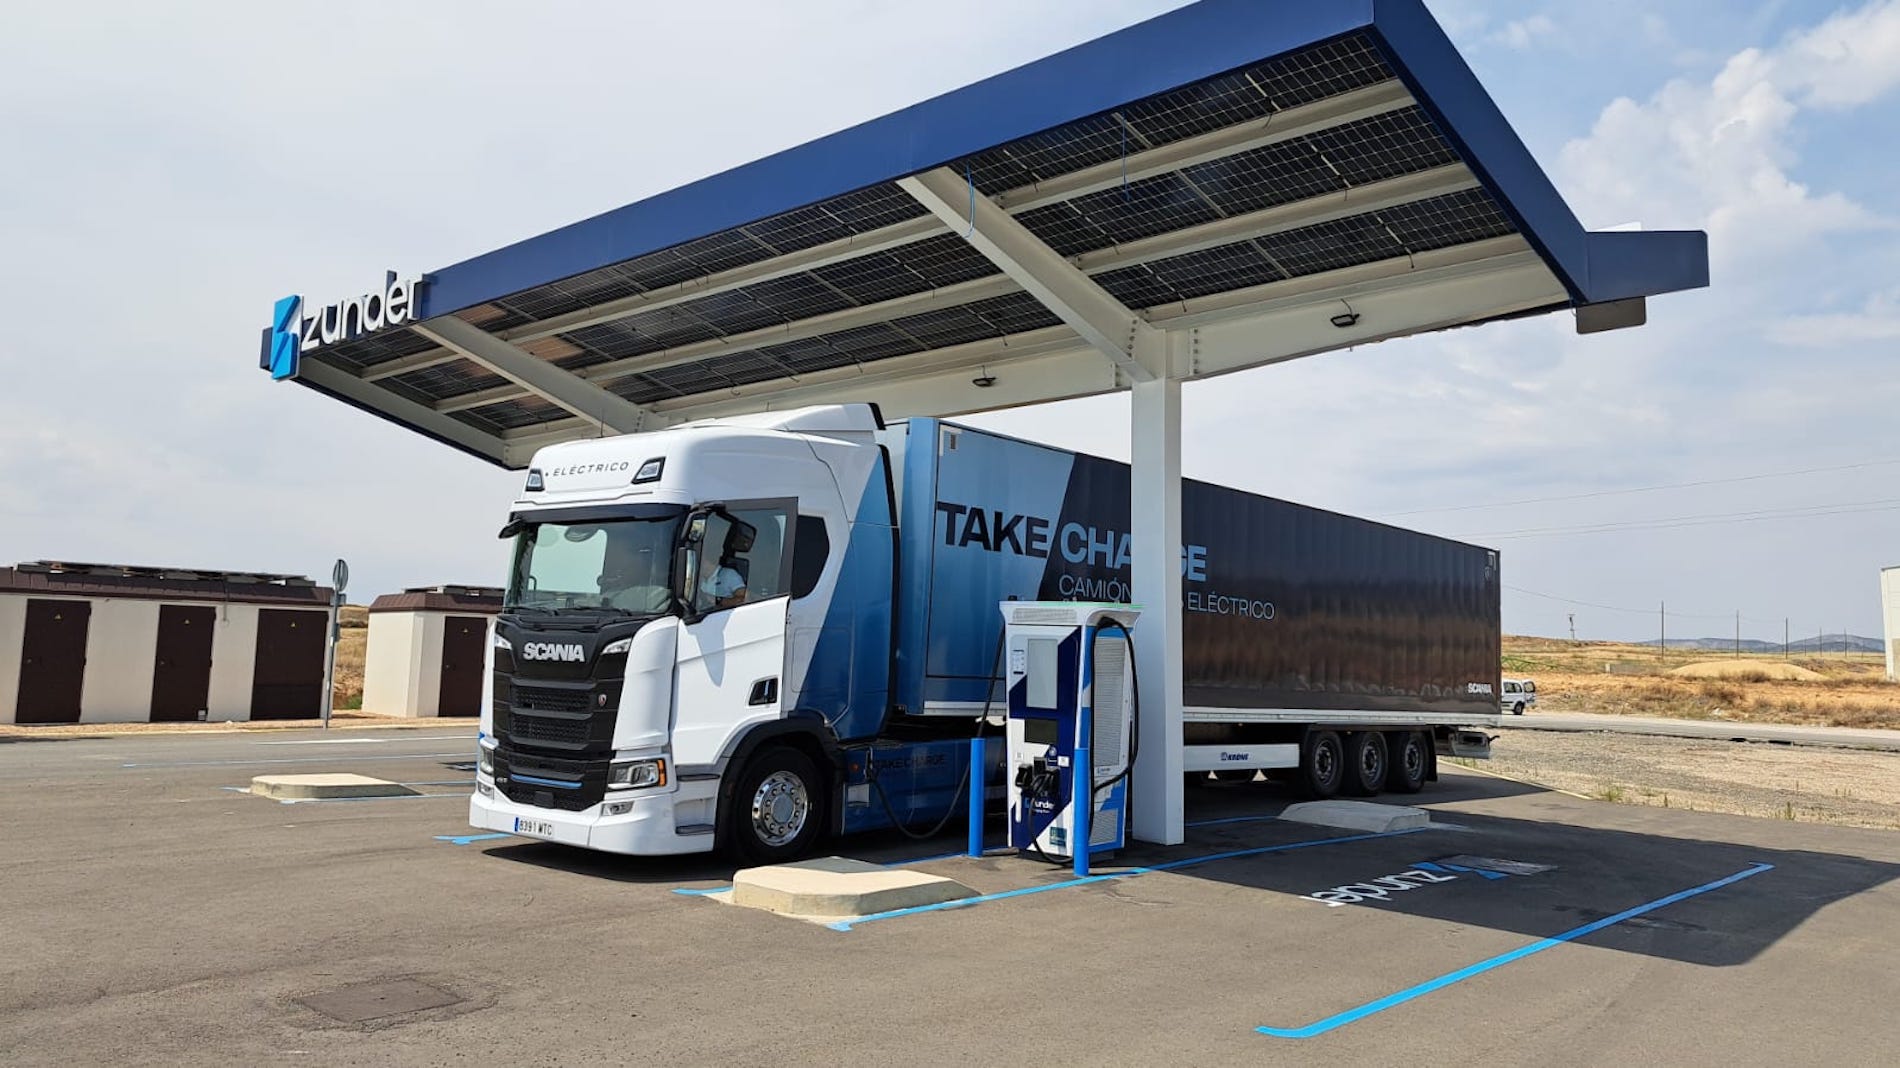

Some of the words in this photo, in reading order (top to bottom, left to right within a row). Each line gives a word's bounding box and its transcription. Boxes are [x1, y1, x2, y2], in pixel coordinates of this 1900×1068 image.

[301, 270, 418, 351] zunder
[936, 500, 1050, 559] TAKE
[1060, 521, 1207, 582] CHAE
[1187, 591, 1275, 620] ELÉCTRICO
[523, 642, 586, 662] SCANIA
[1467, 682, 1493, 694] SCANIA
[1299, 870, 1458, 908] zunder
